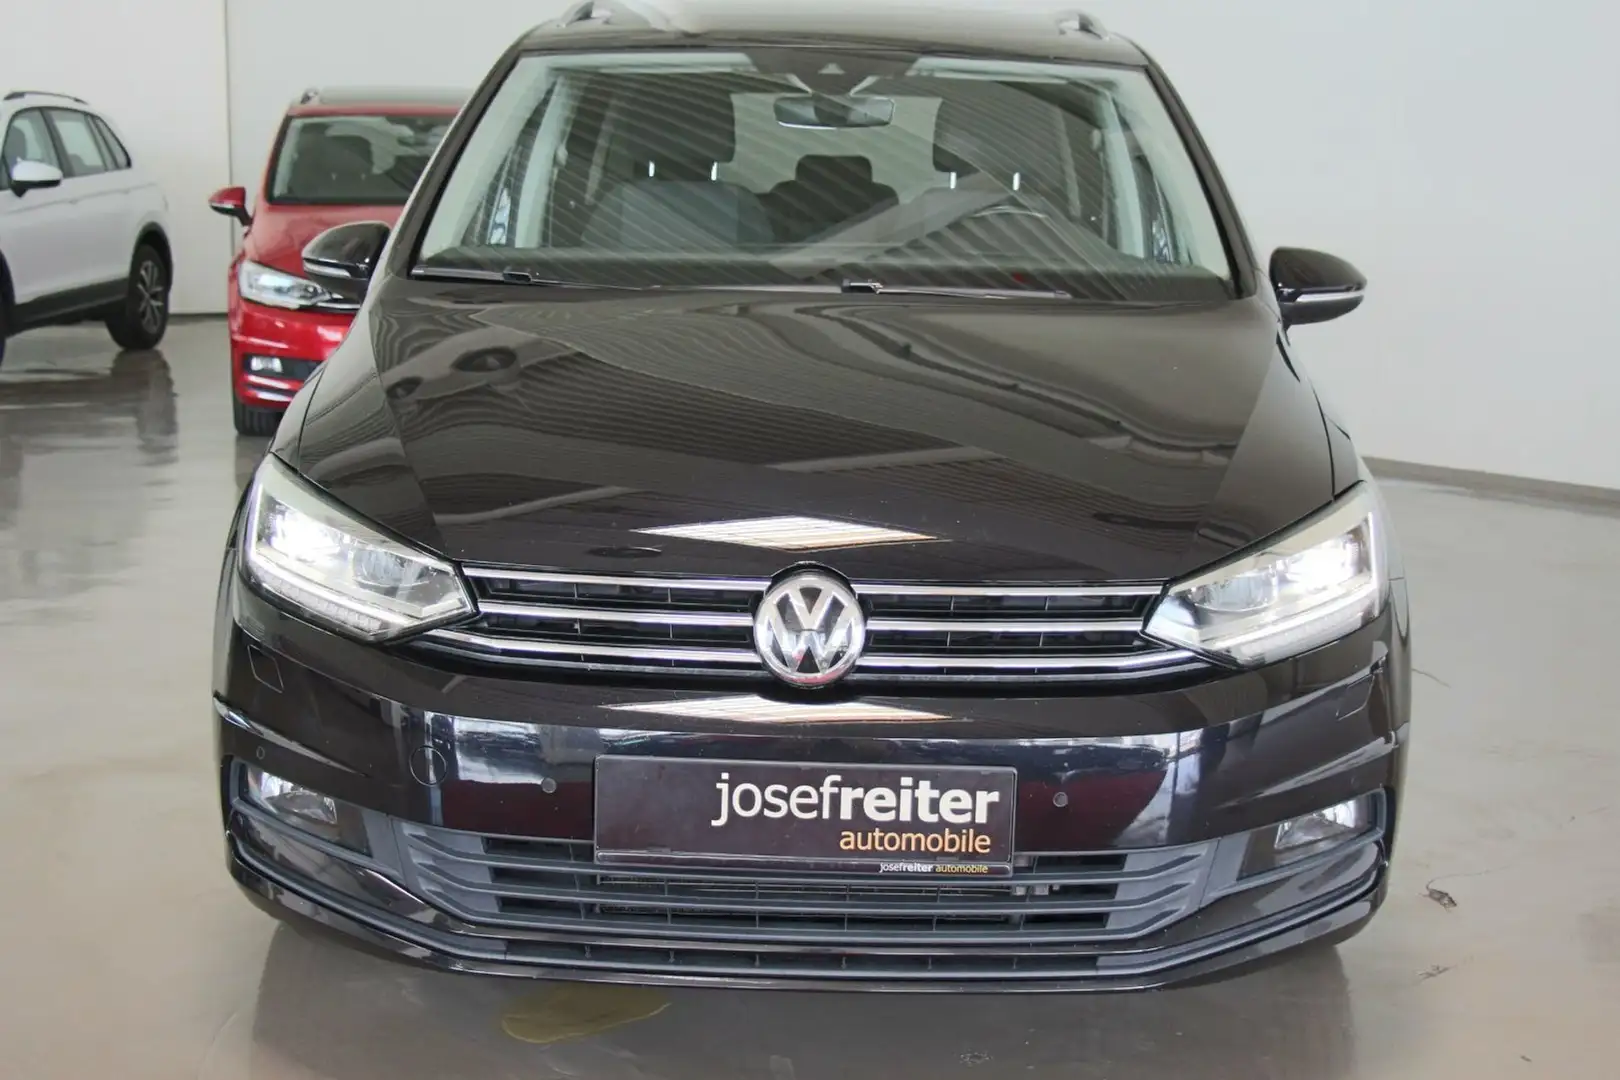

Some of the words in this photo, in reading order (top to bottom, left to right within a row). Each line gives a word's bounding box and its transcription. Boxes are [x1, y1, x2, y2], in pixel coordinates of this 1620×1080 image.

[758, 578, 860, 681] VW
[711, 772, 999, 826] josefreiter
[839, 828, 991, 854] automobile
[879, 861, 933, 873] josefreiter
[935, 863, 988, 874] automobile
